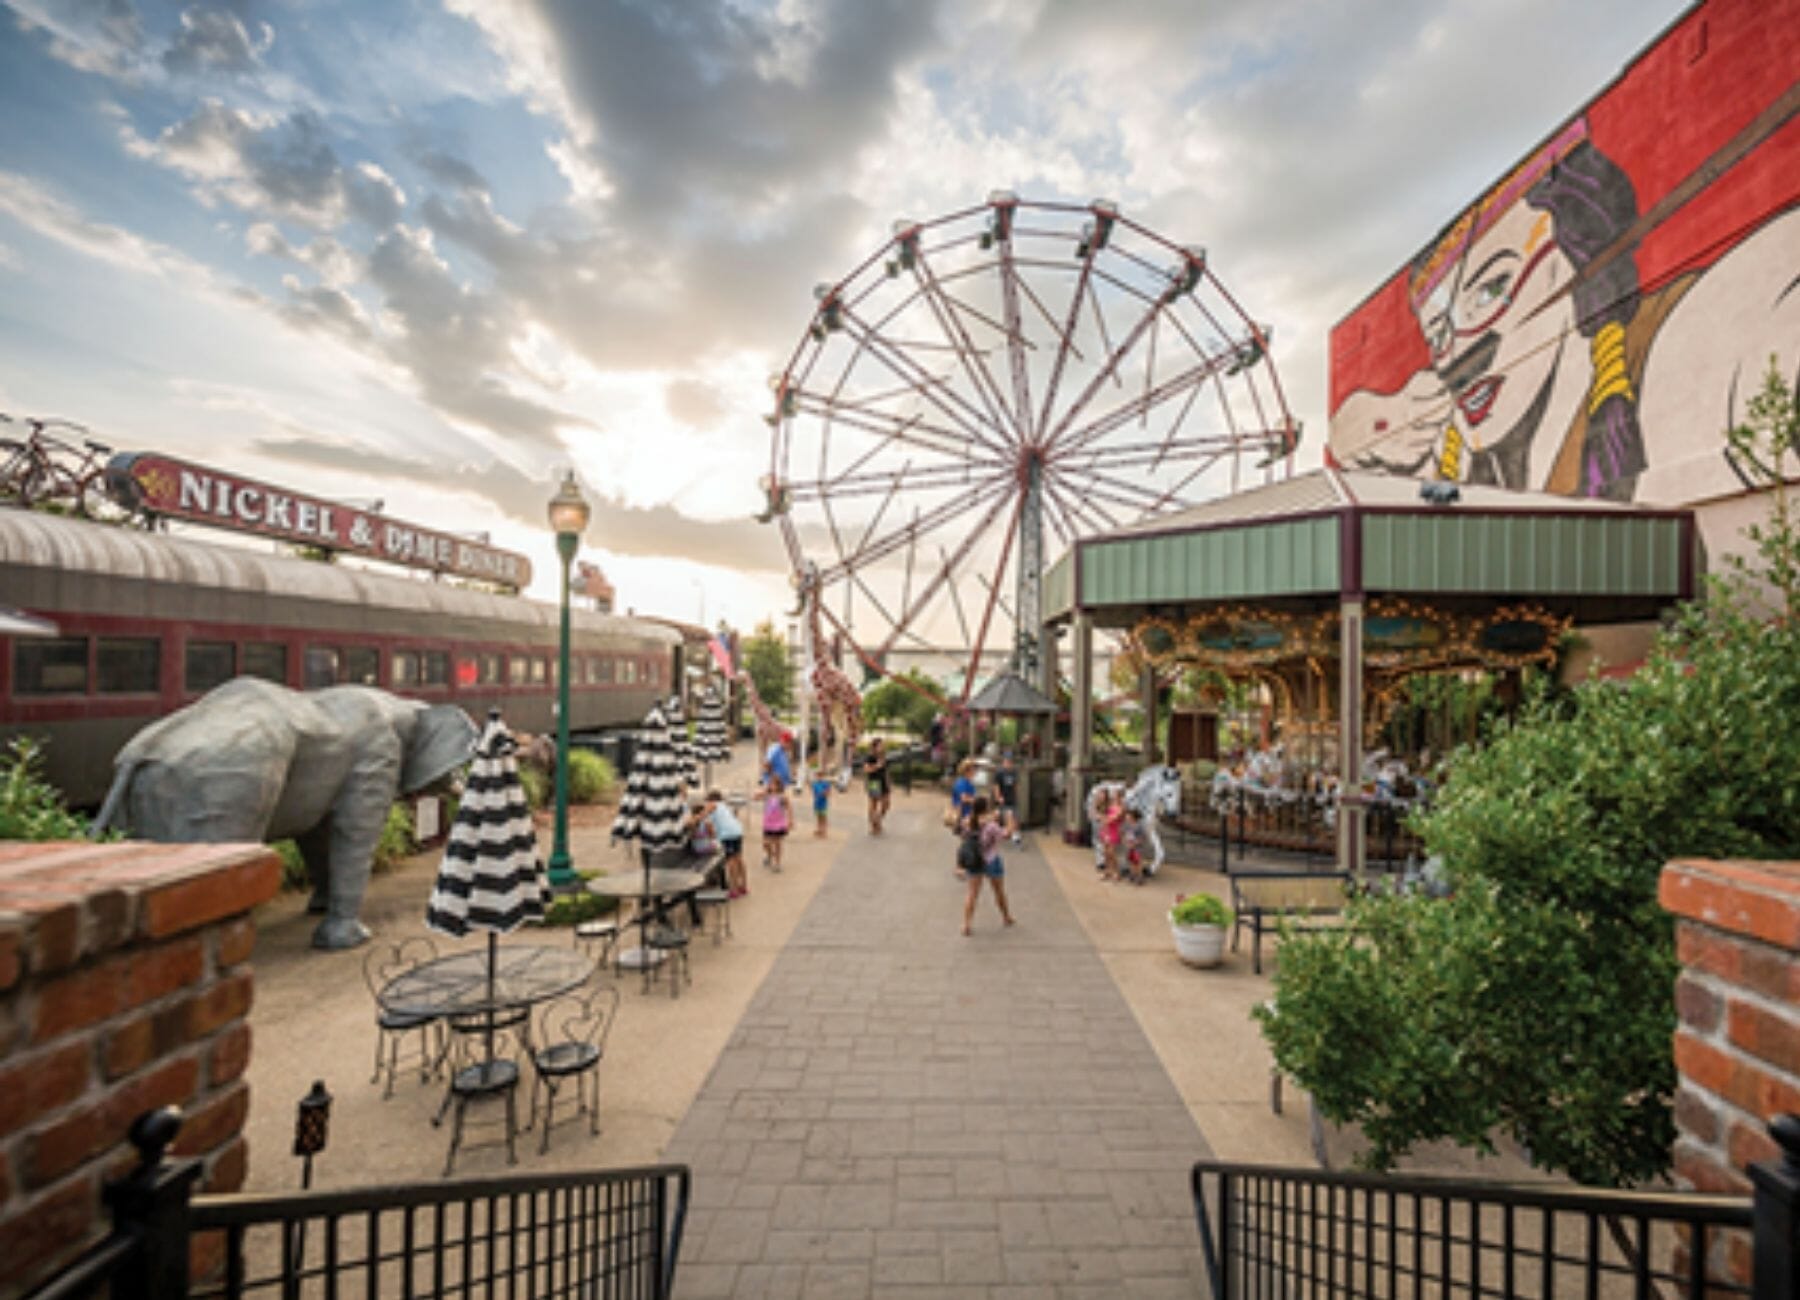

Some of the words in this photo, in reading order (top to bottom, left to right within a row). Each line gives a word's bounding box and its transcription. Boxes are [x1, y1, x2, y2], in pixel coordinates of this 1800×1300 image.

[180, 470, 337, 540] NICKEL
[350, 516, 373, 547] &
[385, 523, 452, 564] DIME
